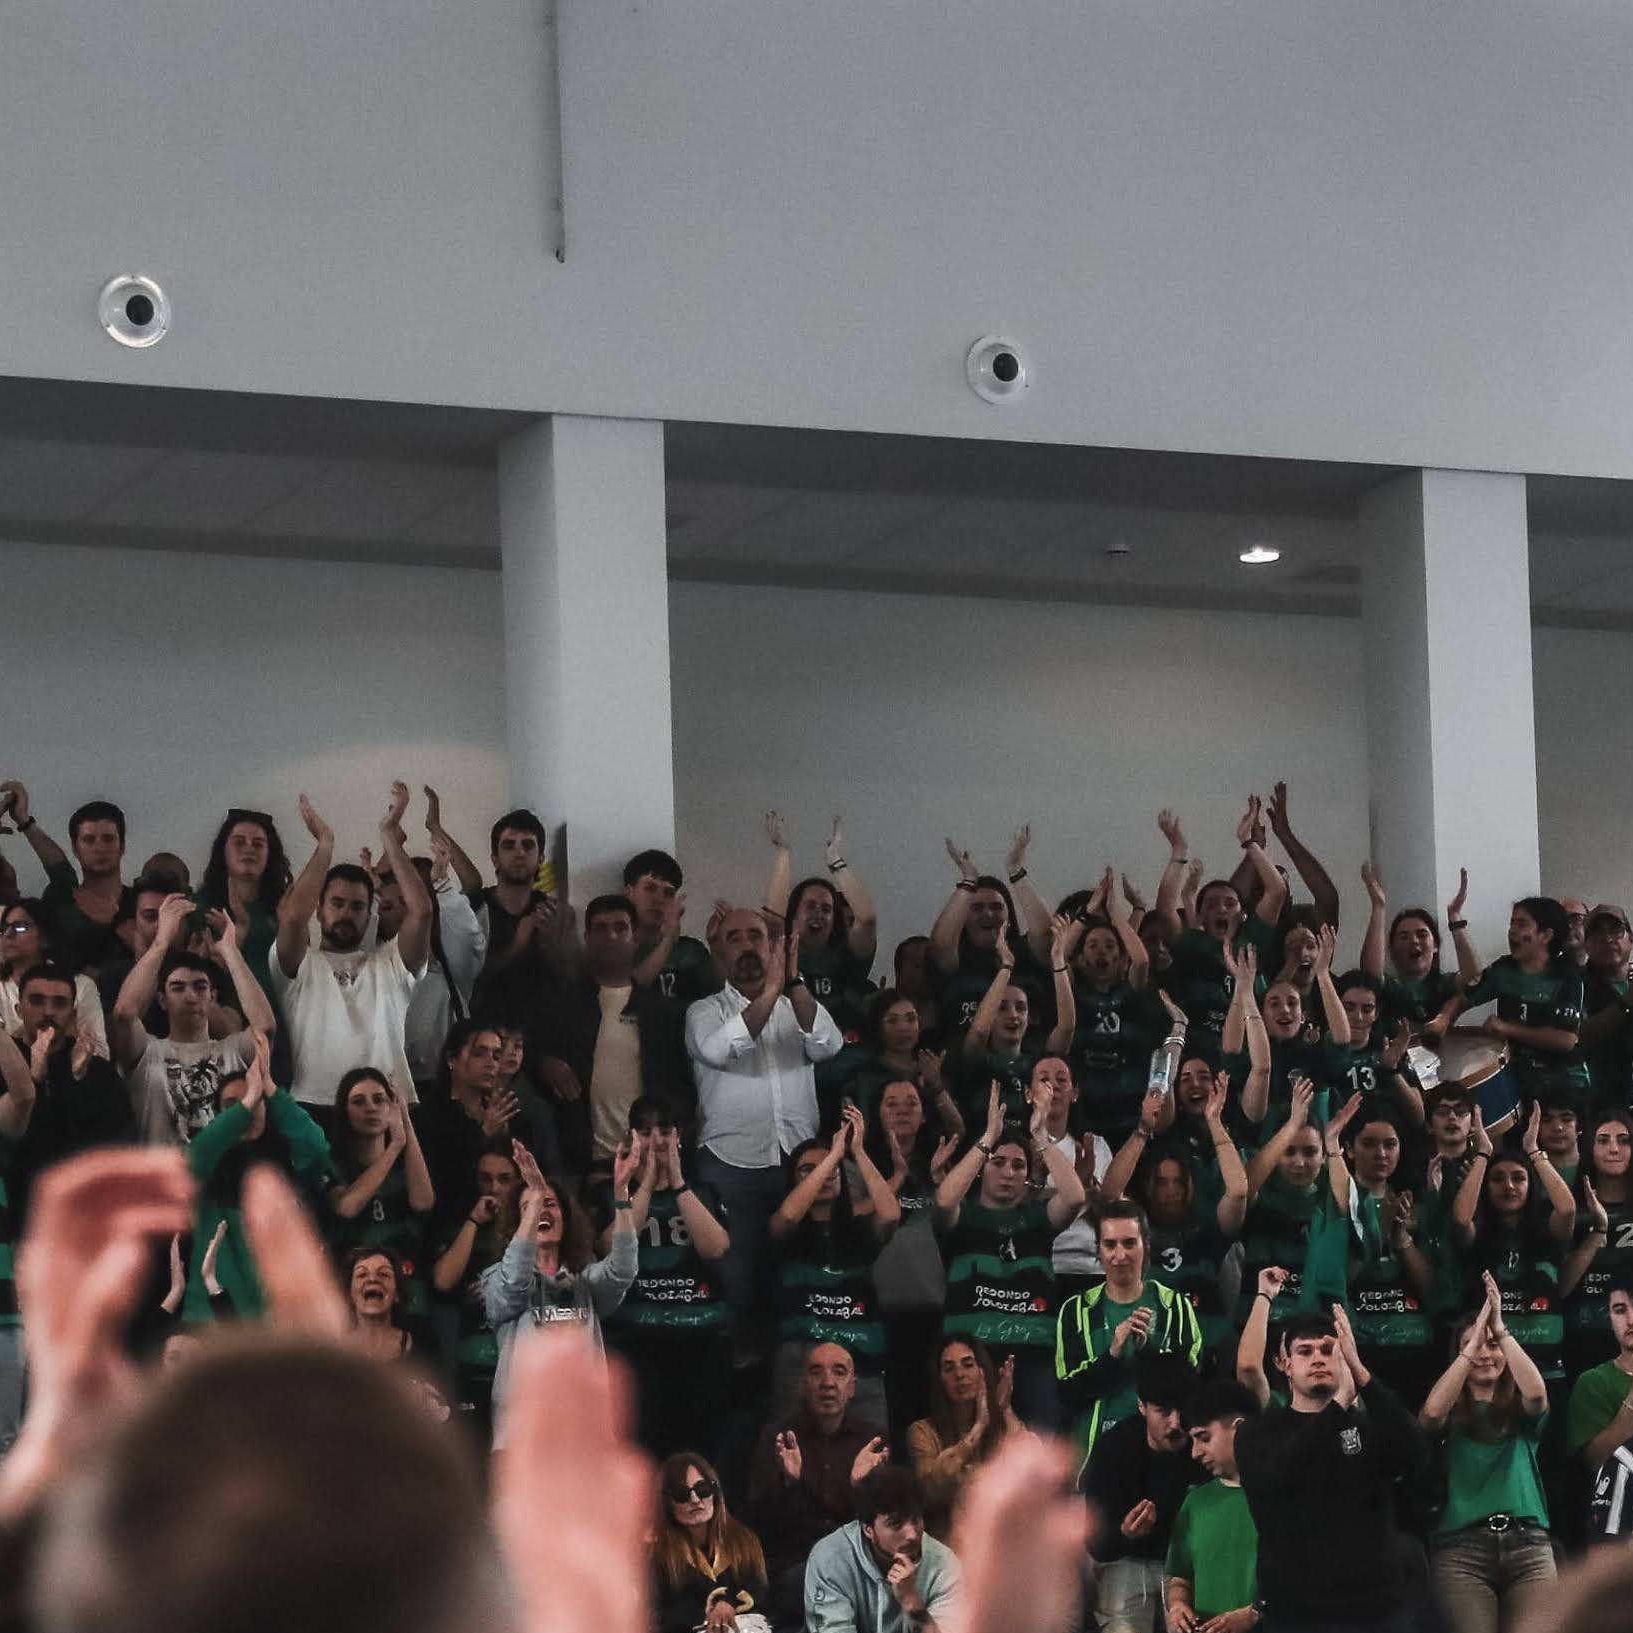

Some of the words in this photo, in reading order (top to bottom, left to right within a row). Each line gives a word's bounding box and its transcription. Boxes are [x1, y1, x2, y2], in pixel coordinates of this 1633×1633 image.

[1346, 1065, 1376, 1092] 13
[1159, 1247, 1183, 1273] 3
[975, 1284, 1031, 1301] REDONDO
